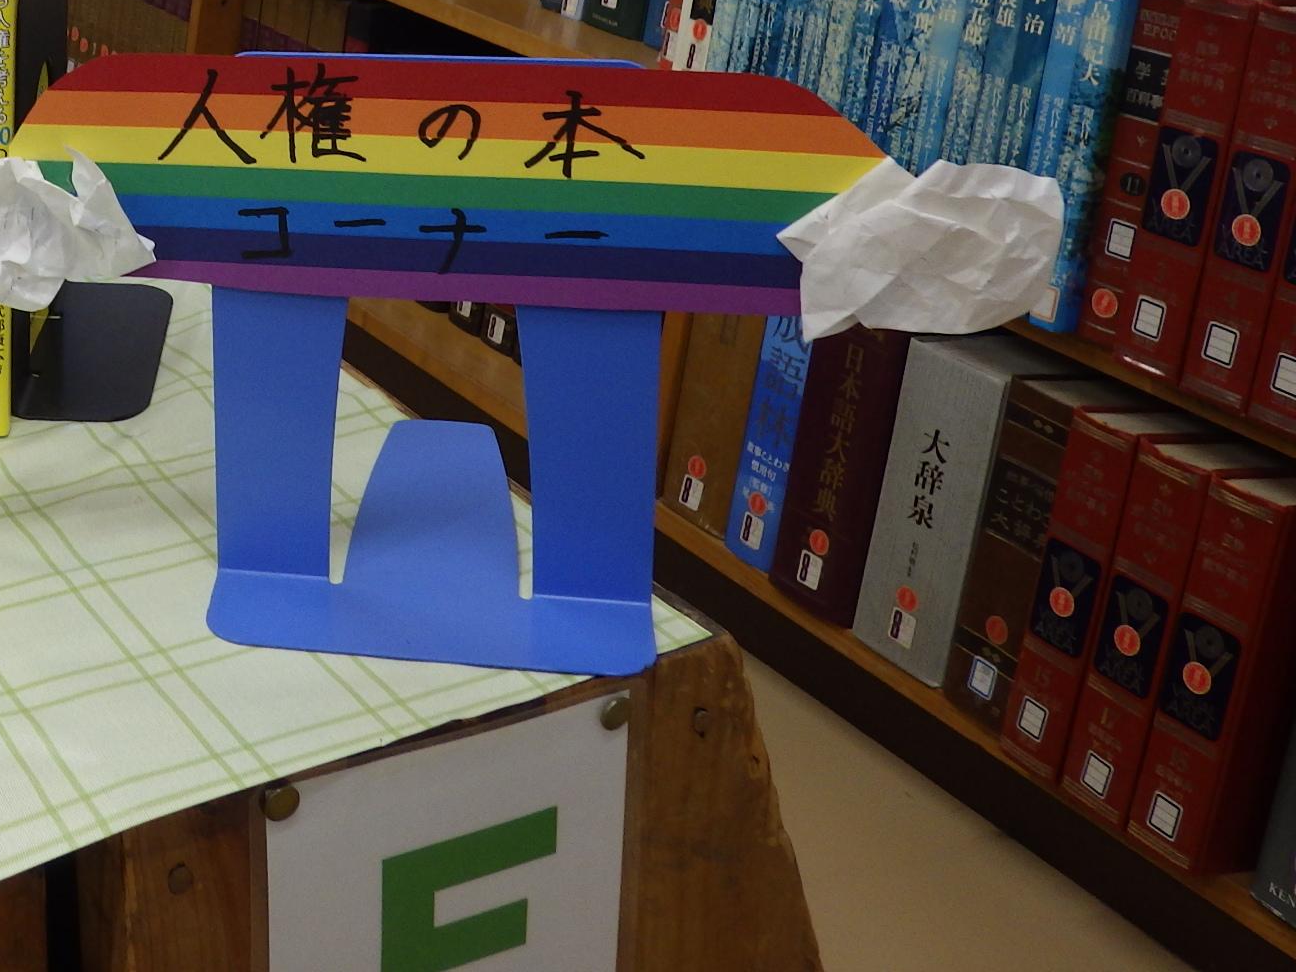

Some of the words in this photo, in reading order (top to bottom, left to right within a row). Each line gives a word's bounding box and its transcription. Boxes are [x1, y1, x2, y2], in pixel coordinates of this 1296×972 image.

[157, 62, 645, 179] 人権の本
[238, 206, 609, 274] コーナー
[812, 344, 865, 519] 日本語大辞典
[907, 429, 950, 529] 大辞泉
